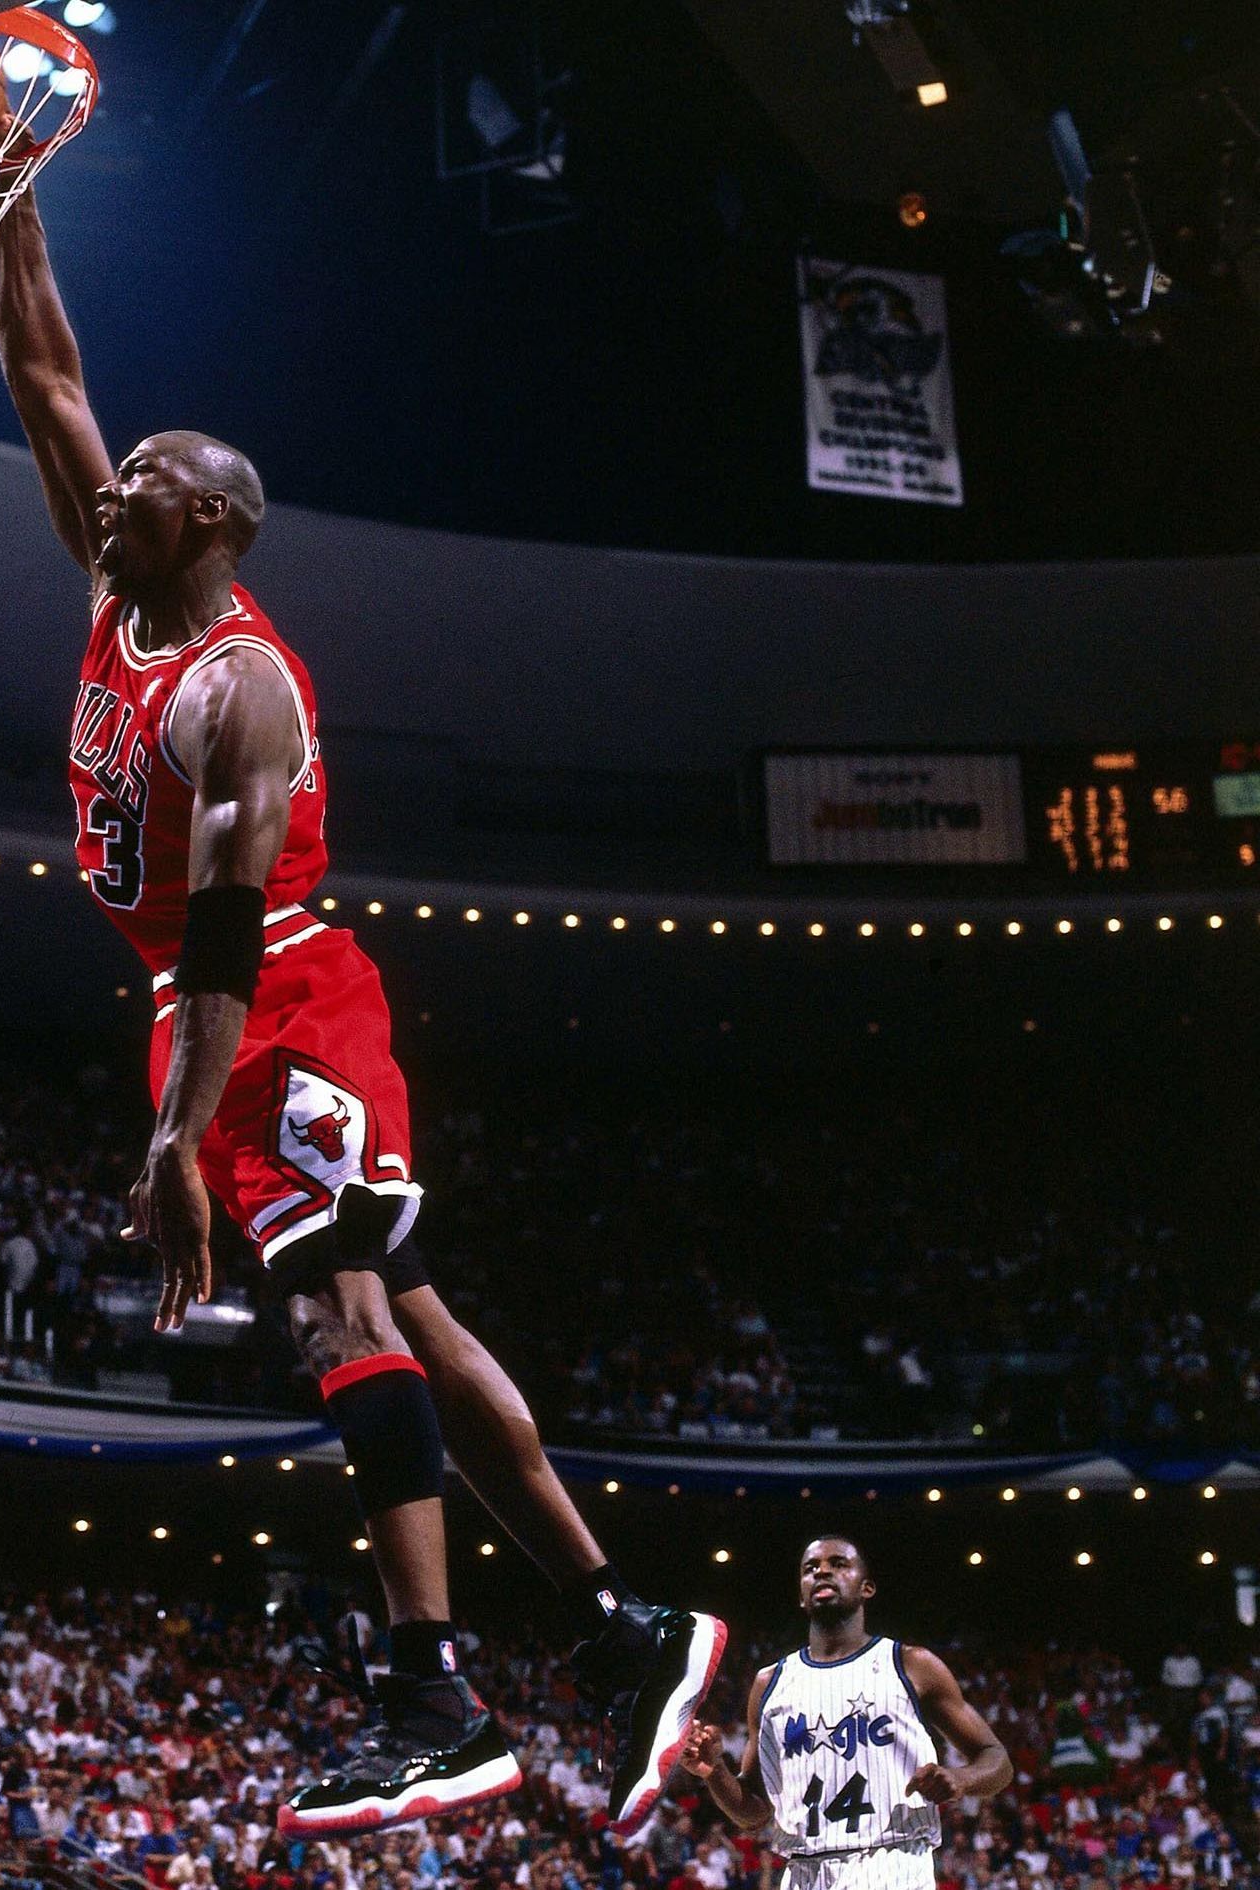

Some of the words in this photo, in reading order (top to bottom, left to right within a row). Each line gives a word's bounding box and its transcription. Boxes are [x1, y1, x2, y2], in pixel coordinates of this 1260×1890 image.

[69, 680, 152, 826] ULLS
[70, 783, 145, 911] 3
[802, 1770, 876, 1838] 14
